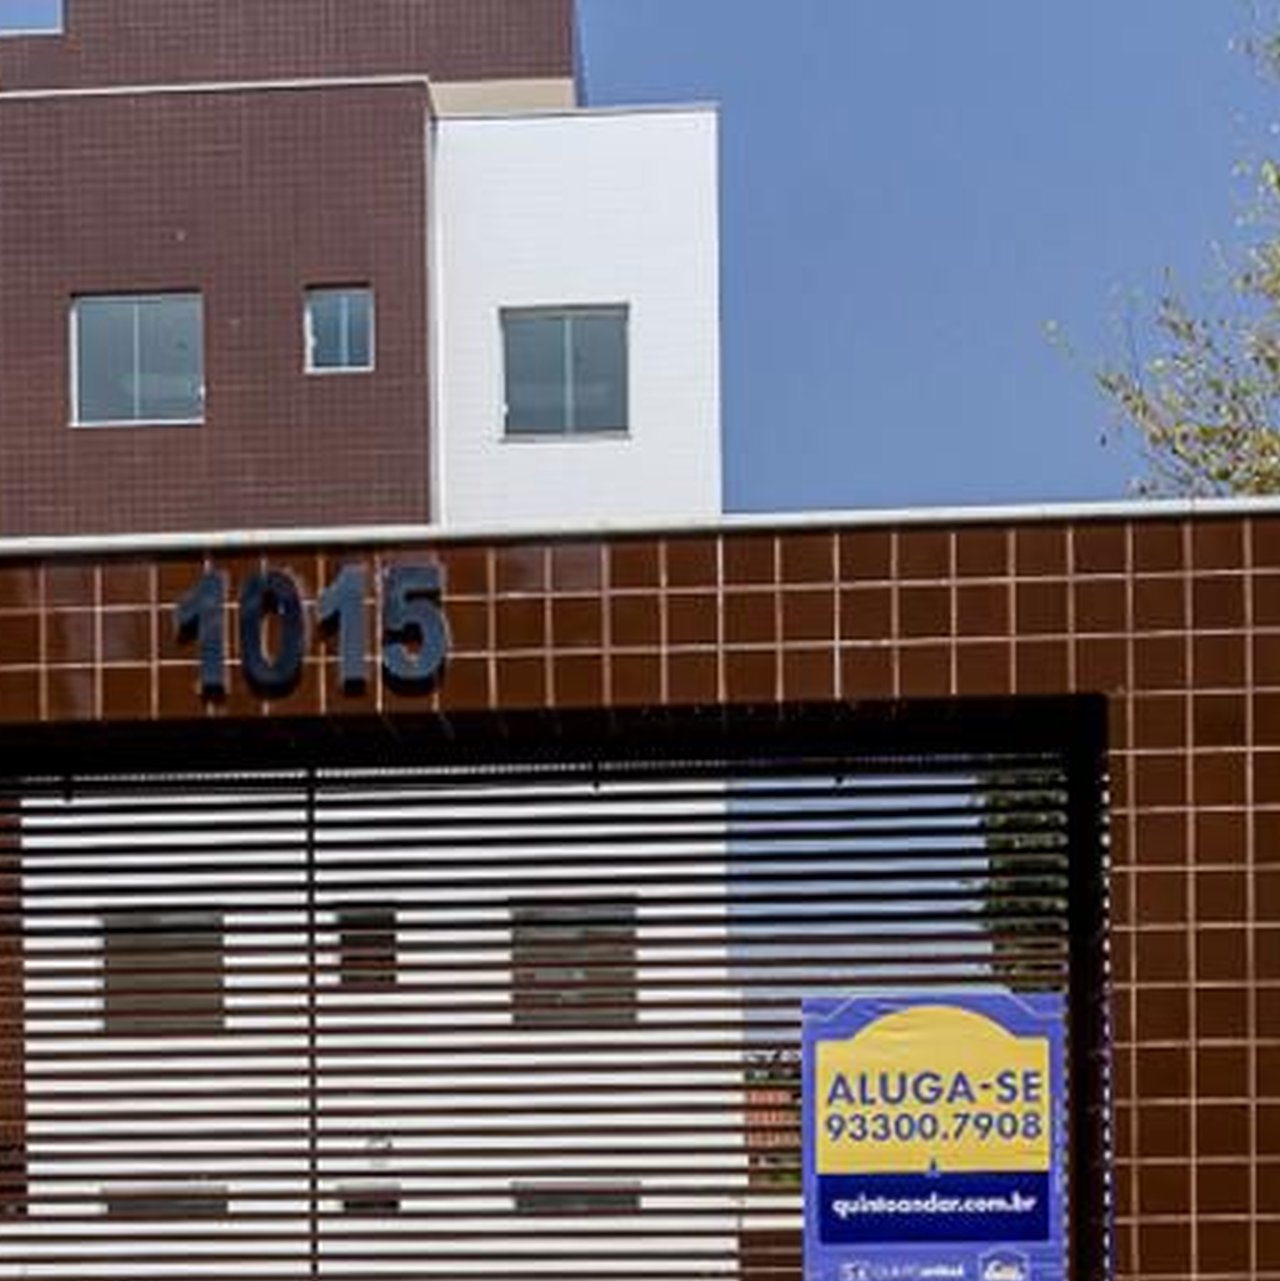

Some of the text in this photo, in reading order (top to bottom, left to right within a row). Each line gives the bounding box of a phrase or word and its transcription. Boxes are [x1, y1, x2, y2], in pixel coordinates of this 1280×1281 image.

[176, 558, 450, 694] 1015
[826, 1070, 1043, 1106] ALUGA-SE
[825, 1113, 1043, 1143] 93300.7908
[831, 1191, 1038, 1219] quintoandar.com.br
